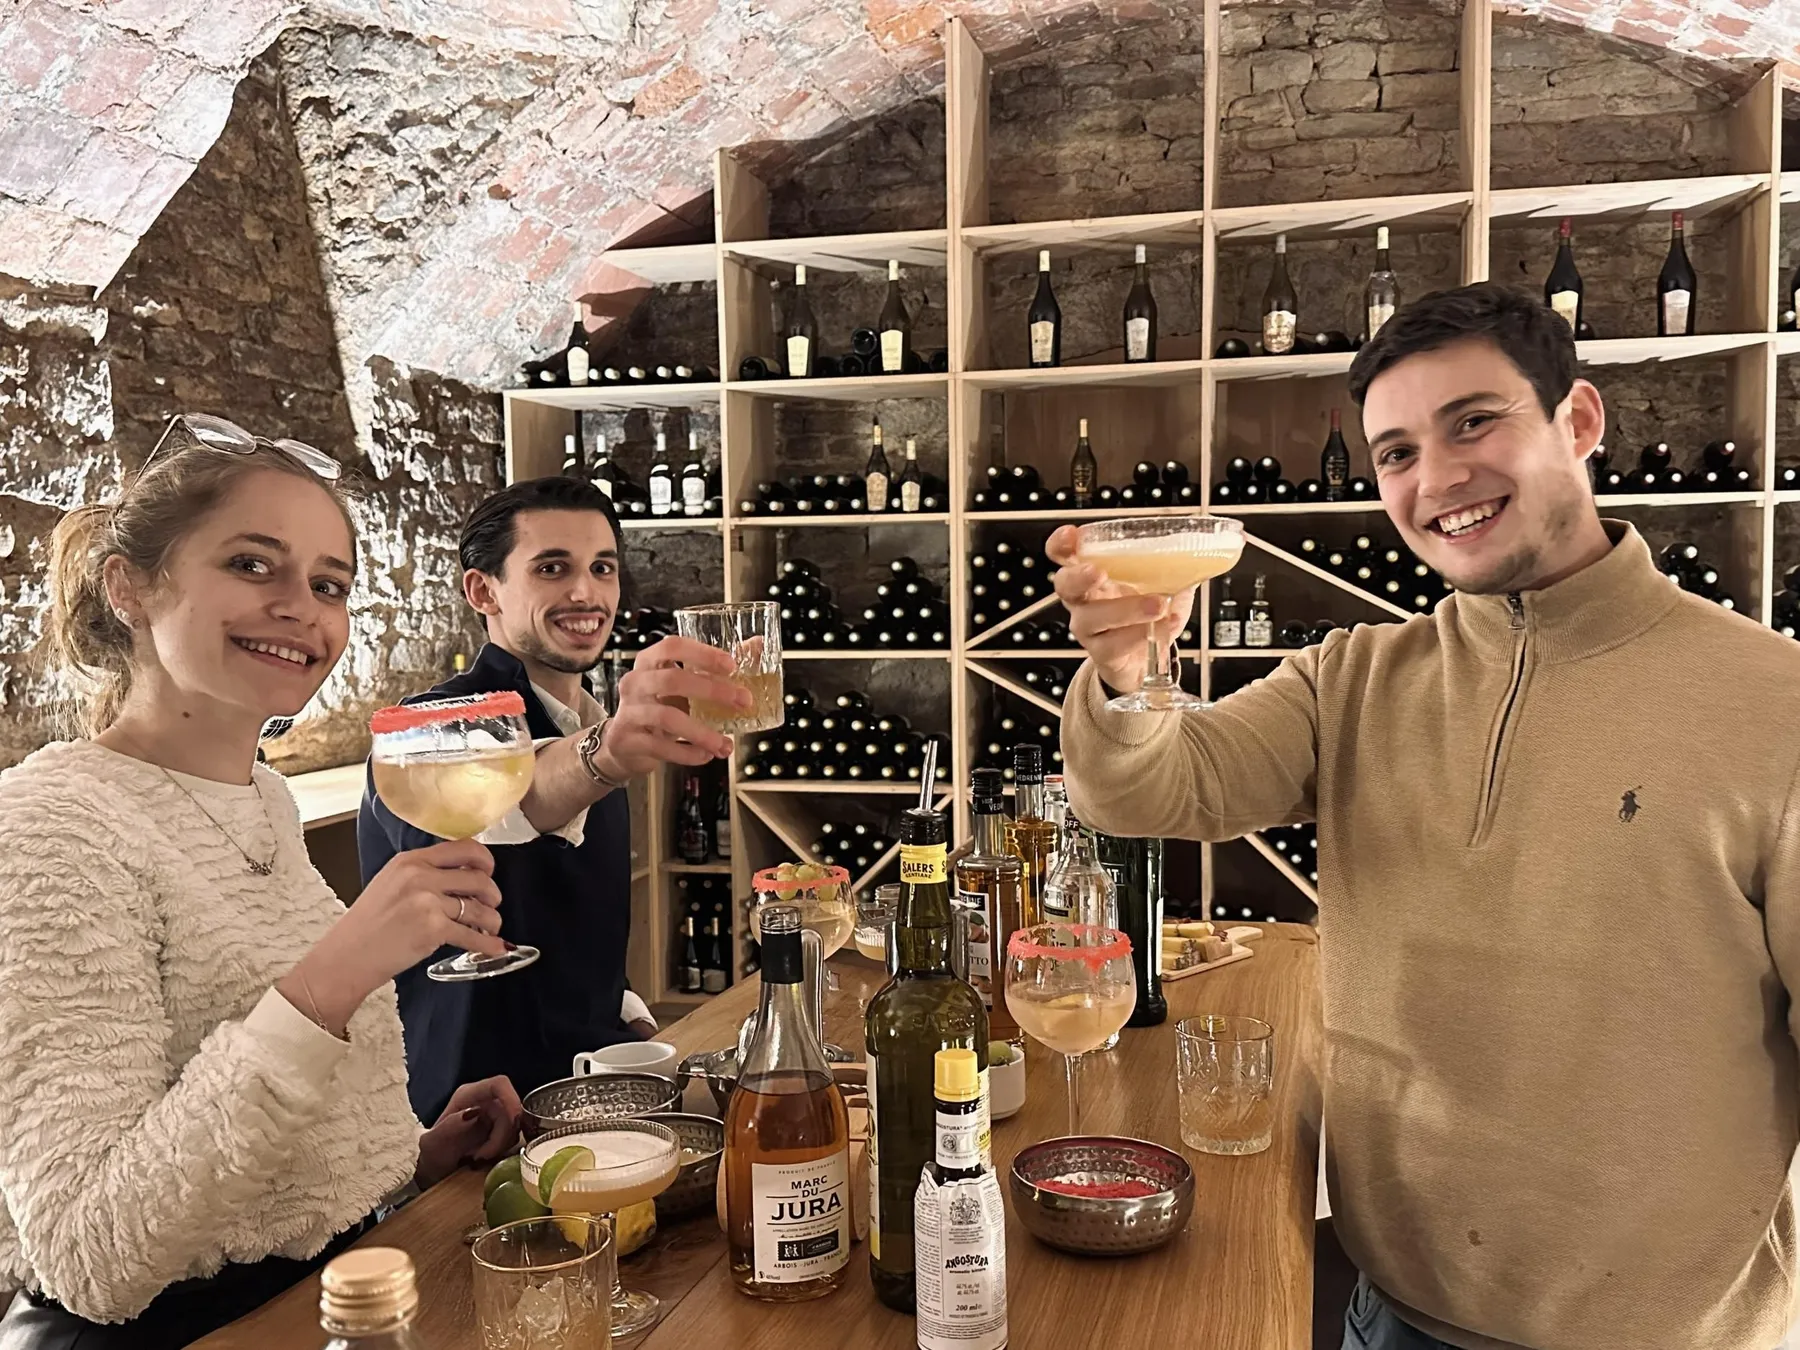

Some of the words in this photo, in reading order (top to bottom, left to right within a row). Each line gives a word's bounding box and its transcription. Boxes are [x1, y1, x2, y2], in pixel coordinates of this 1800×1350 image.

[902, 861, 934, 874] SALERS
[791, 1175, 828, 1190] MARC
[802, 1187, 819, 1198] DU
[771, 1191, 842, 1221] JURA
[803, 1258, 819, 1268] JURA
[945, 1254, 989, 1269] ANGOSTURA
